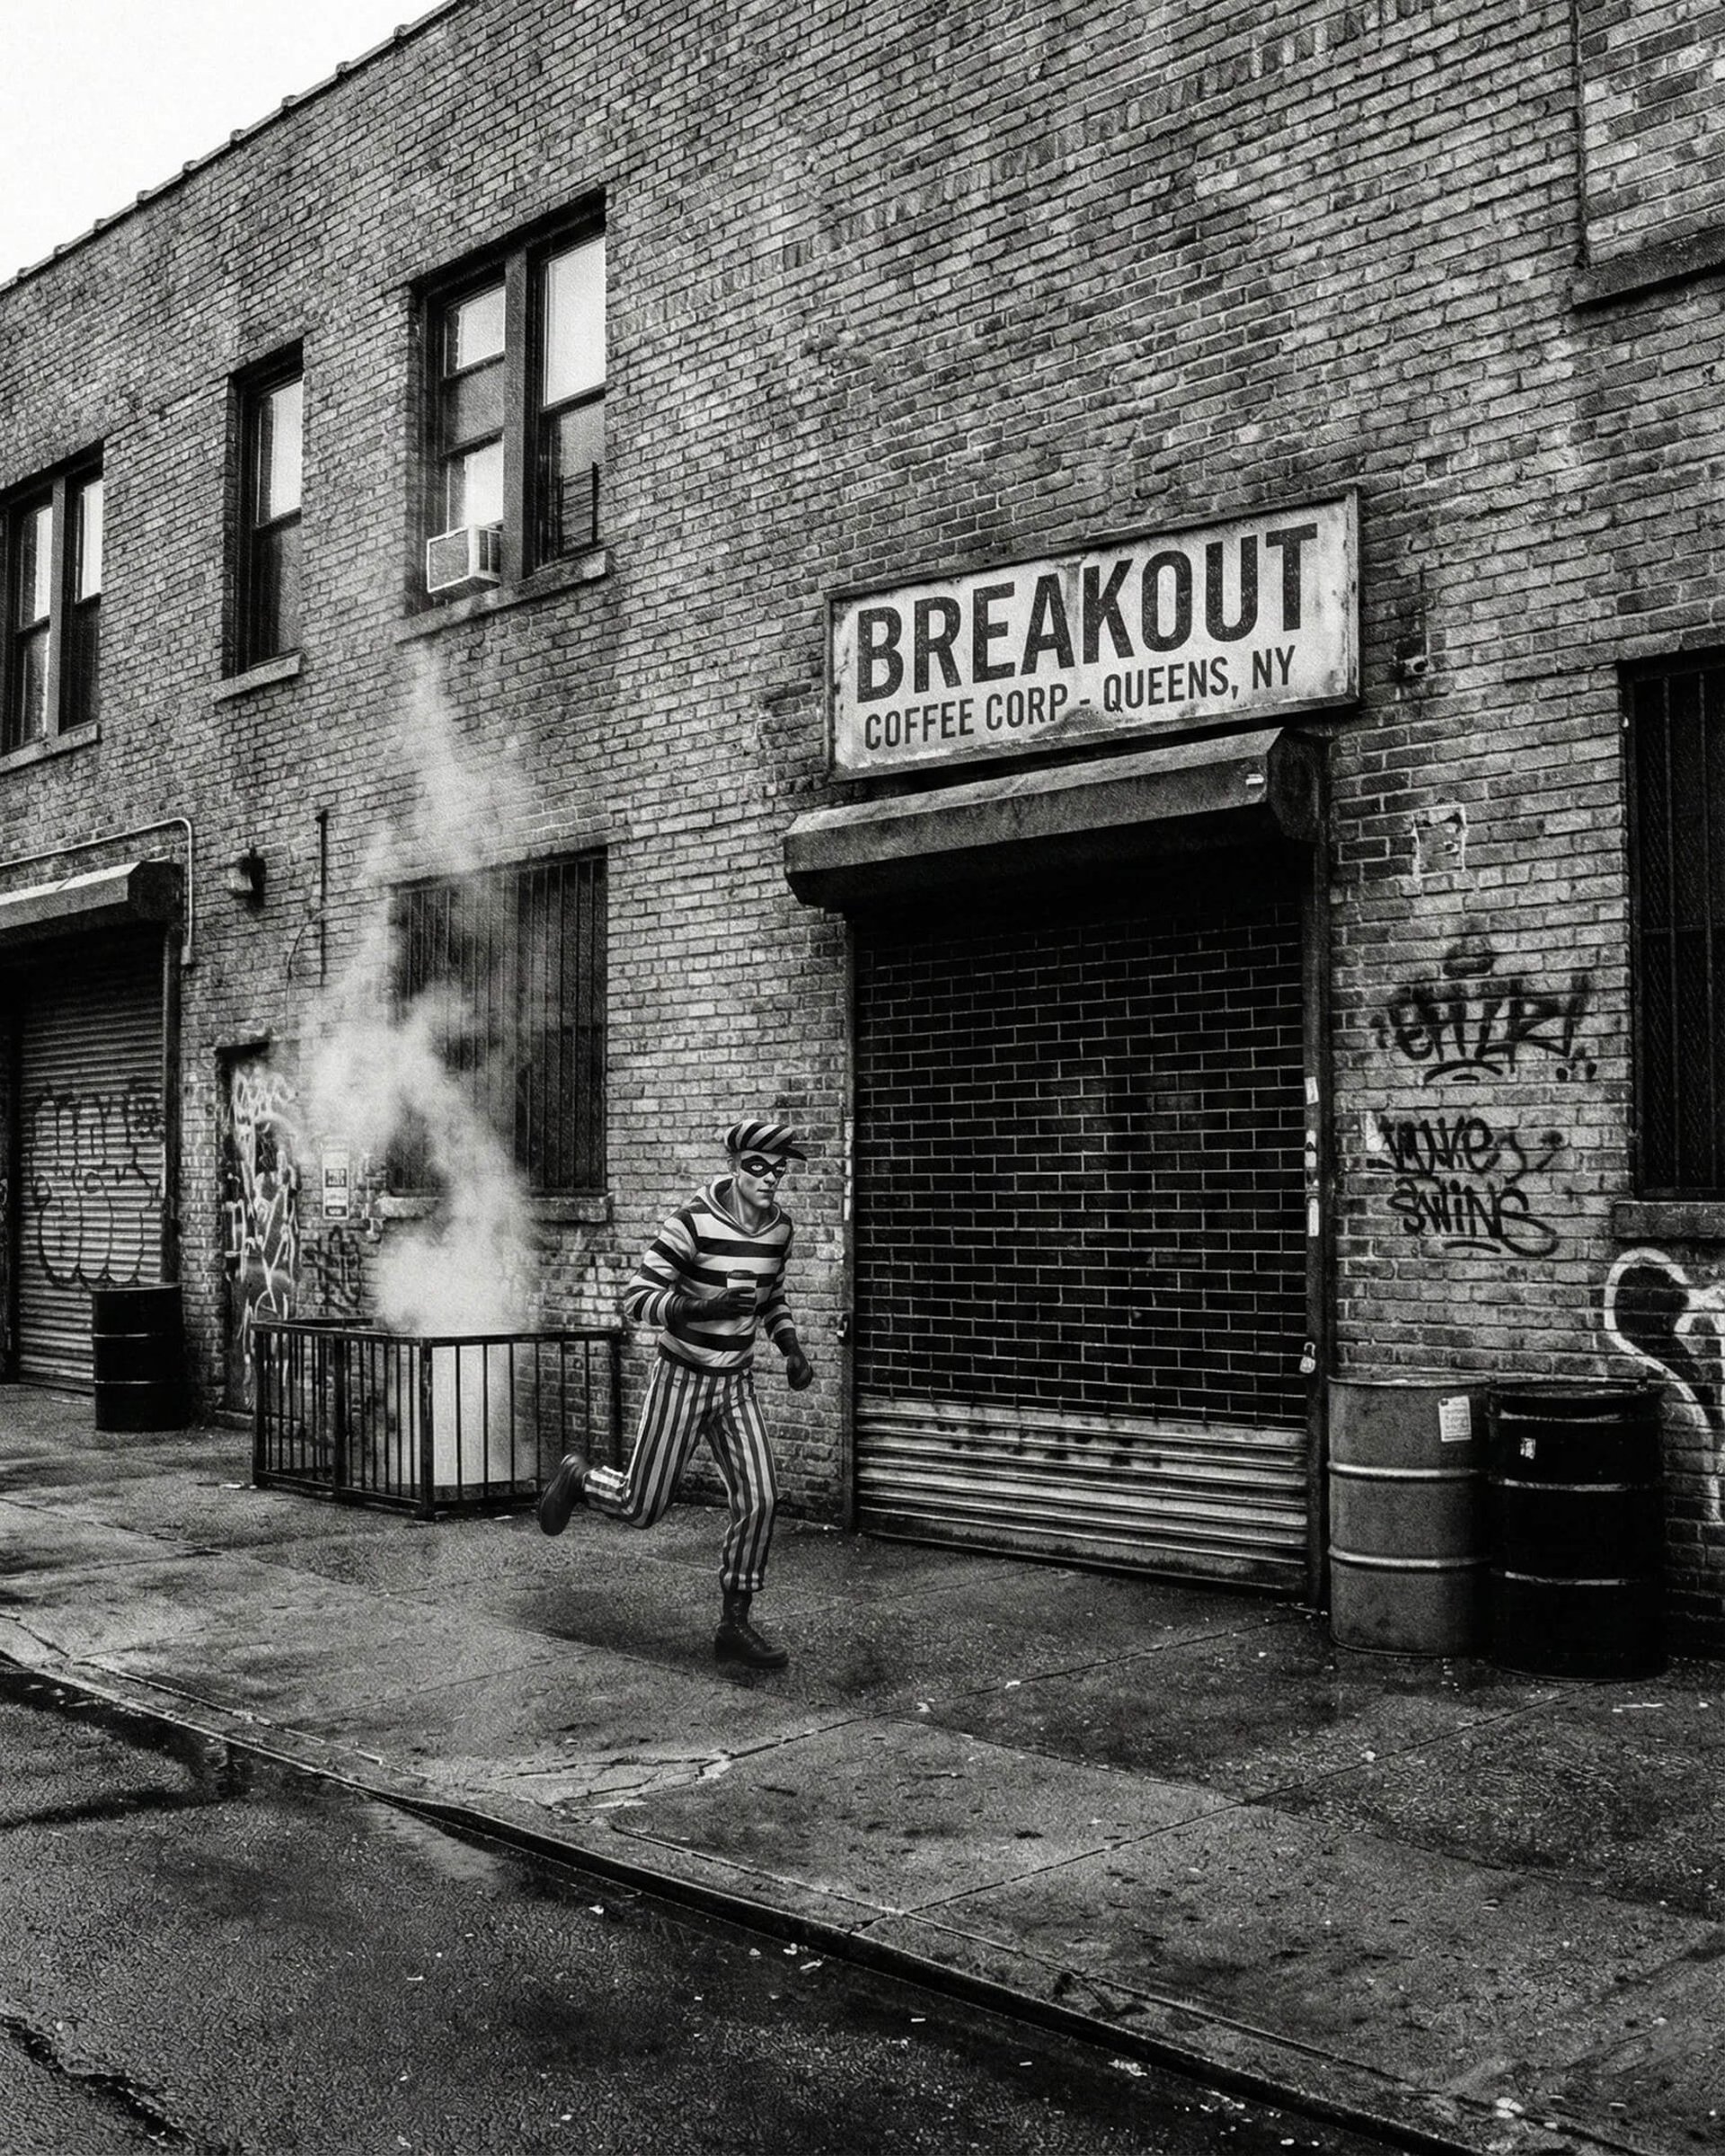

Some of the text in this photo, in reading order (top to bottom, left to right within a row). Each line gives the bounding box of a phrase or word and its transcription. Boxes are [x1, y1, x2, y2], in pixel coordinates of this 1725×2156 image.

[856, 522, 1318, 703] BREAKOUT
[864, 644, 1296, 751] COFFEE CORP - QUEENS, NY
